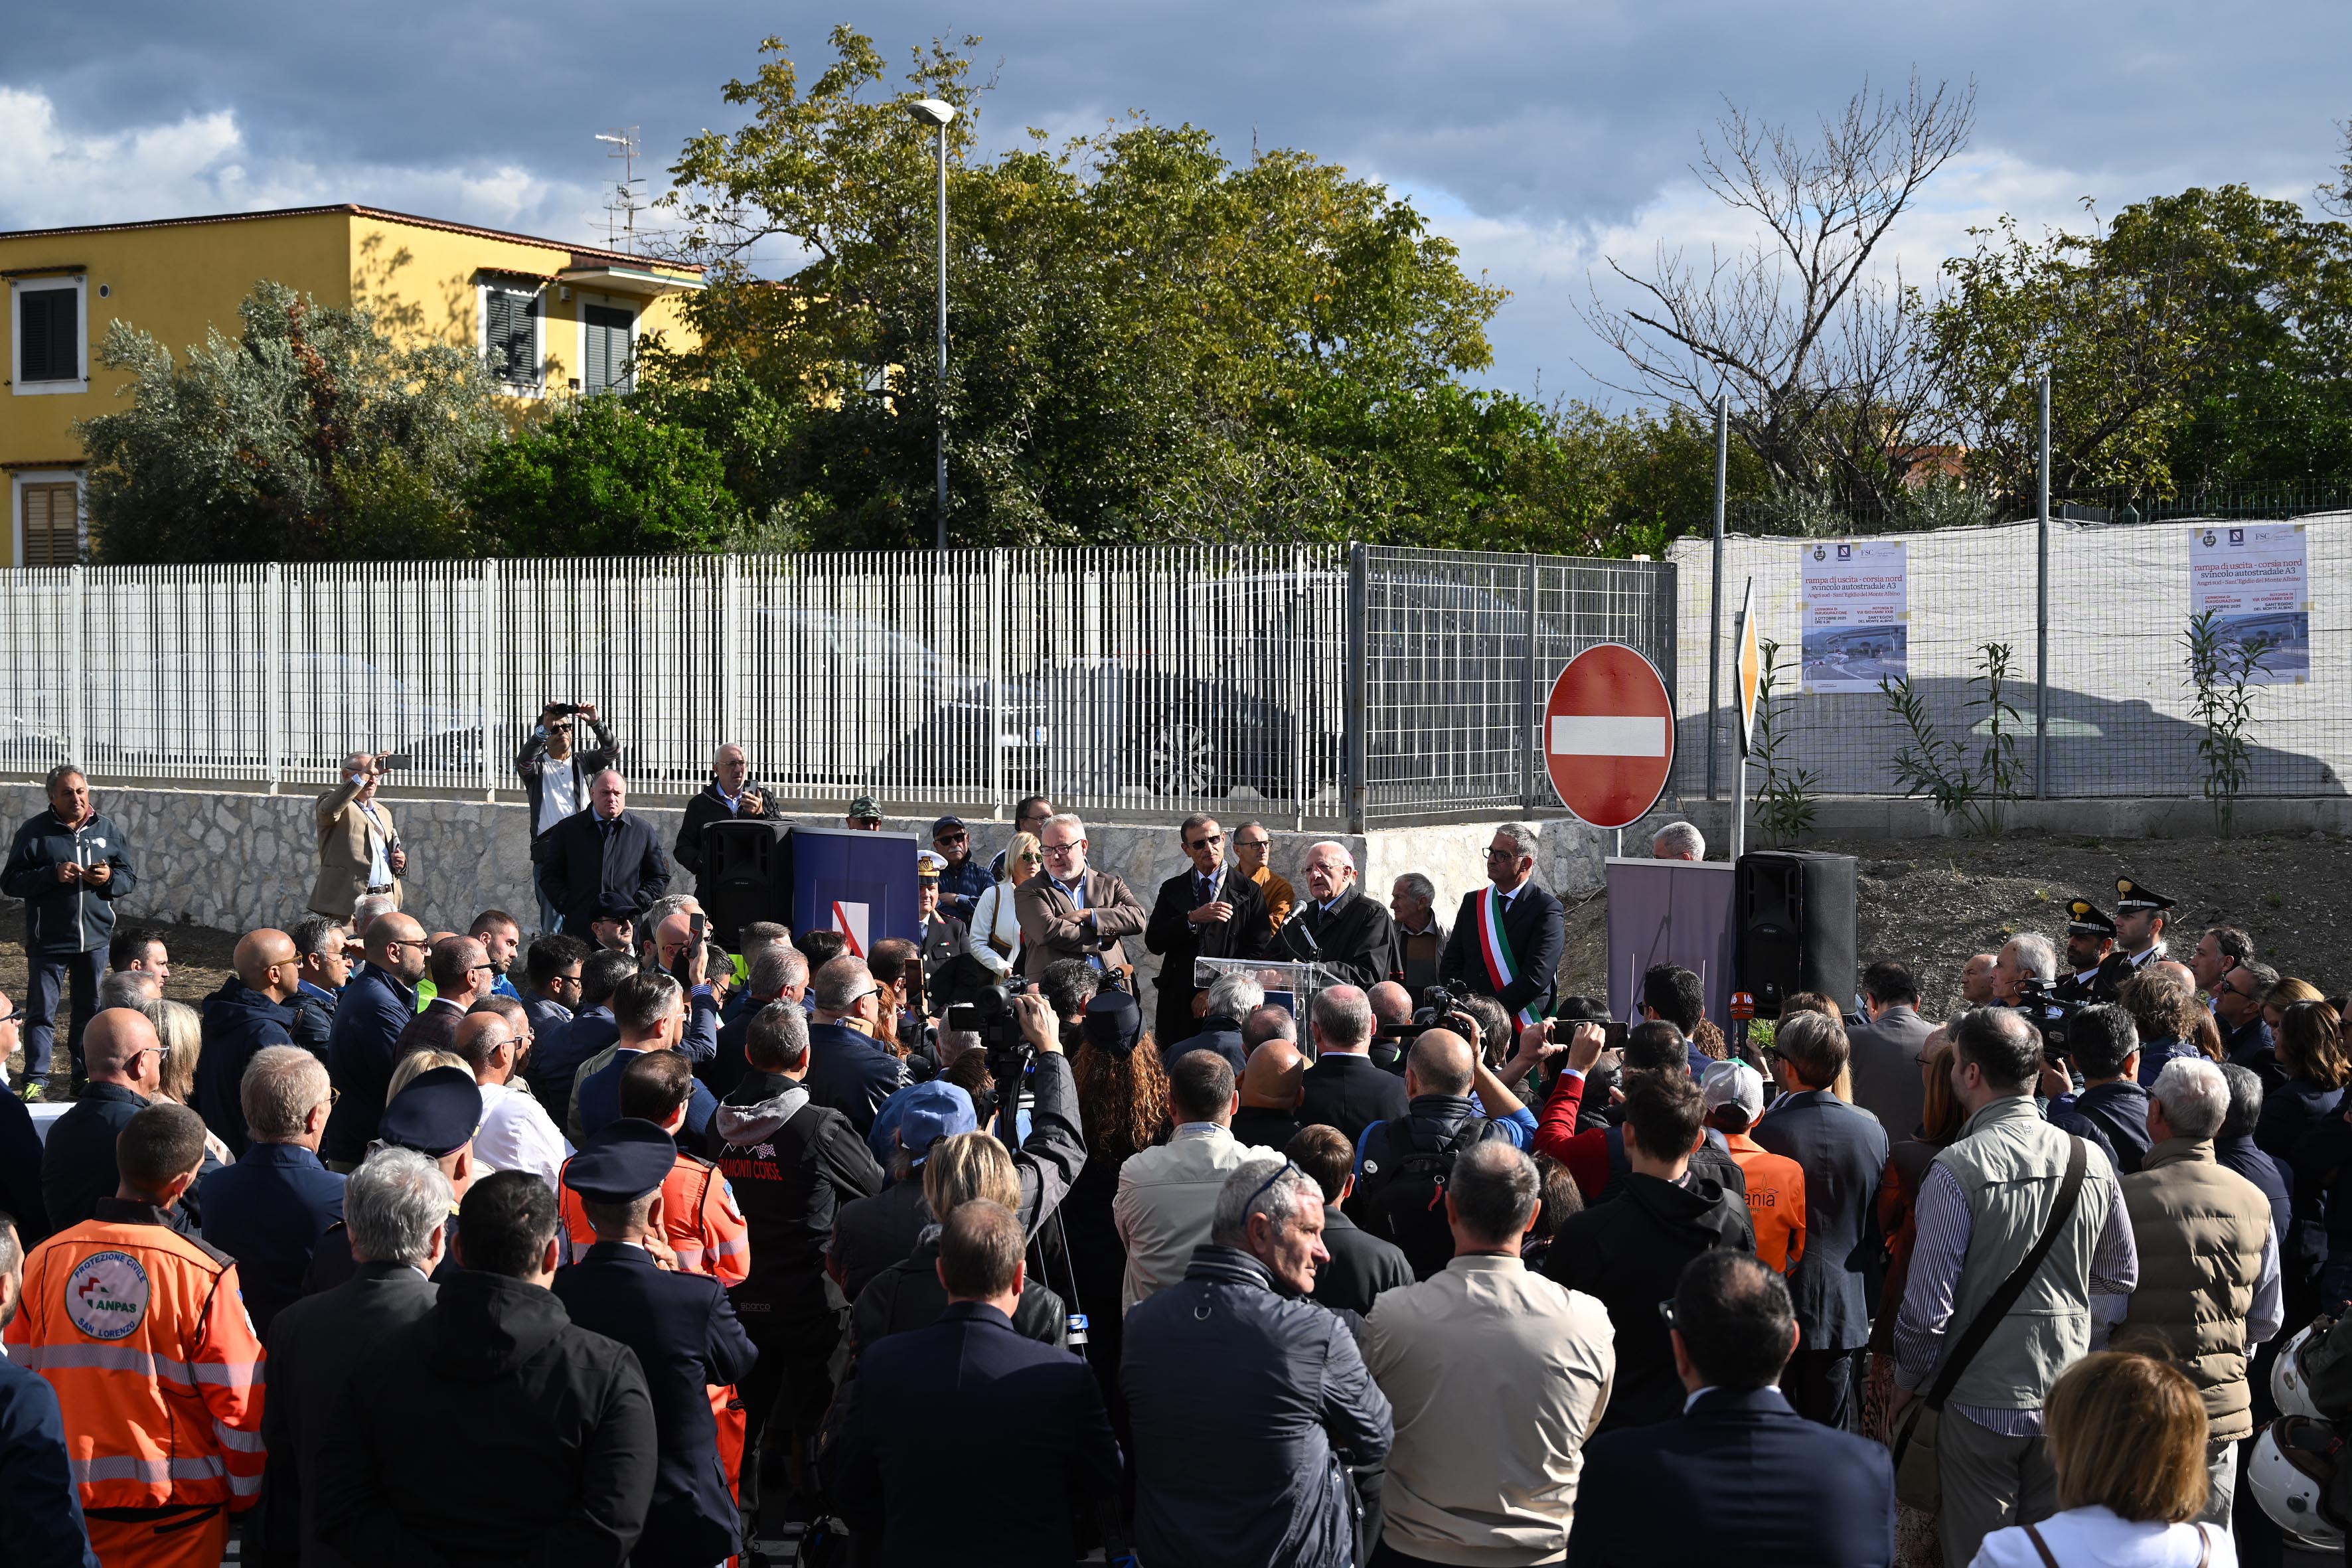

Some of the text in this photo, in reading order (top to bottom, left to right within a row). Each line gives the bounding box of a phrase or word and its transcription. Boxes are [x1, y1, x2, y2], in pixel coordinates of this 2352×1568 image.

[2234, 568, 2283, 577] autostradale
[1743, 994, 1753, 1004] 16
[753, 1160, 783, 1181] CORSE
[1745, 1193, 1775, 1207] ania
[74, 1253, 146, 1283] PROTEZIONE CIVILE
[96, 1300, 137, 1313] ANPAS
[740, 1302, 771, 1312] sparco
[78, 1318, 135, 1338] SAN LORENZO
